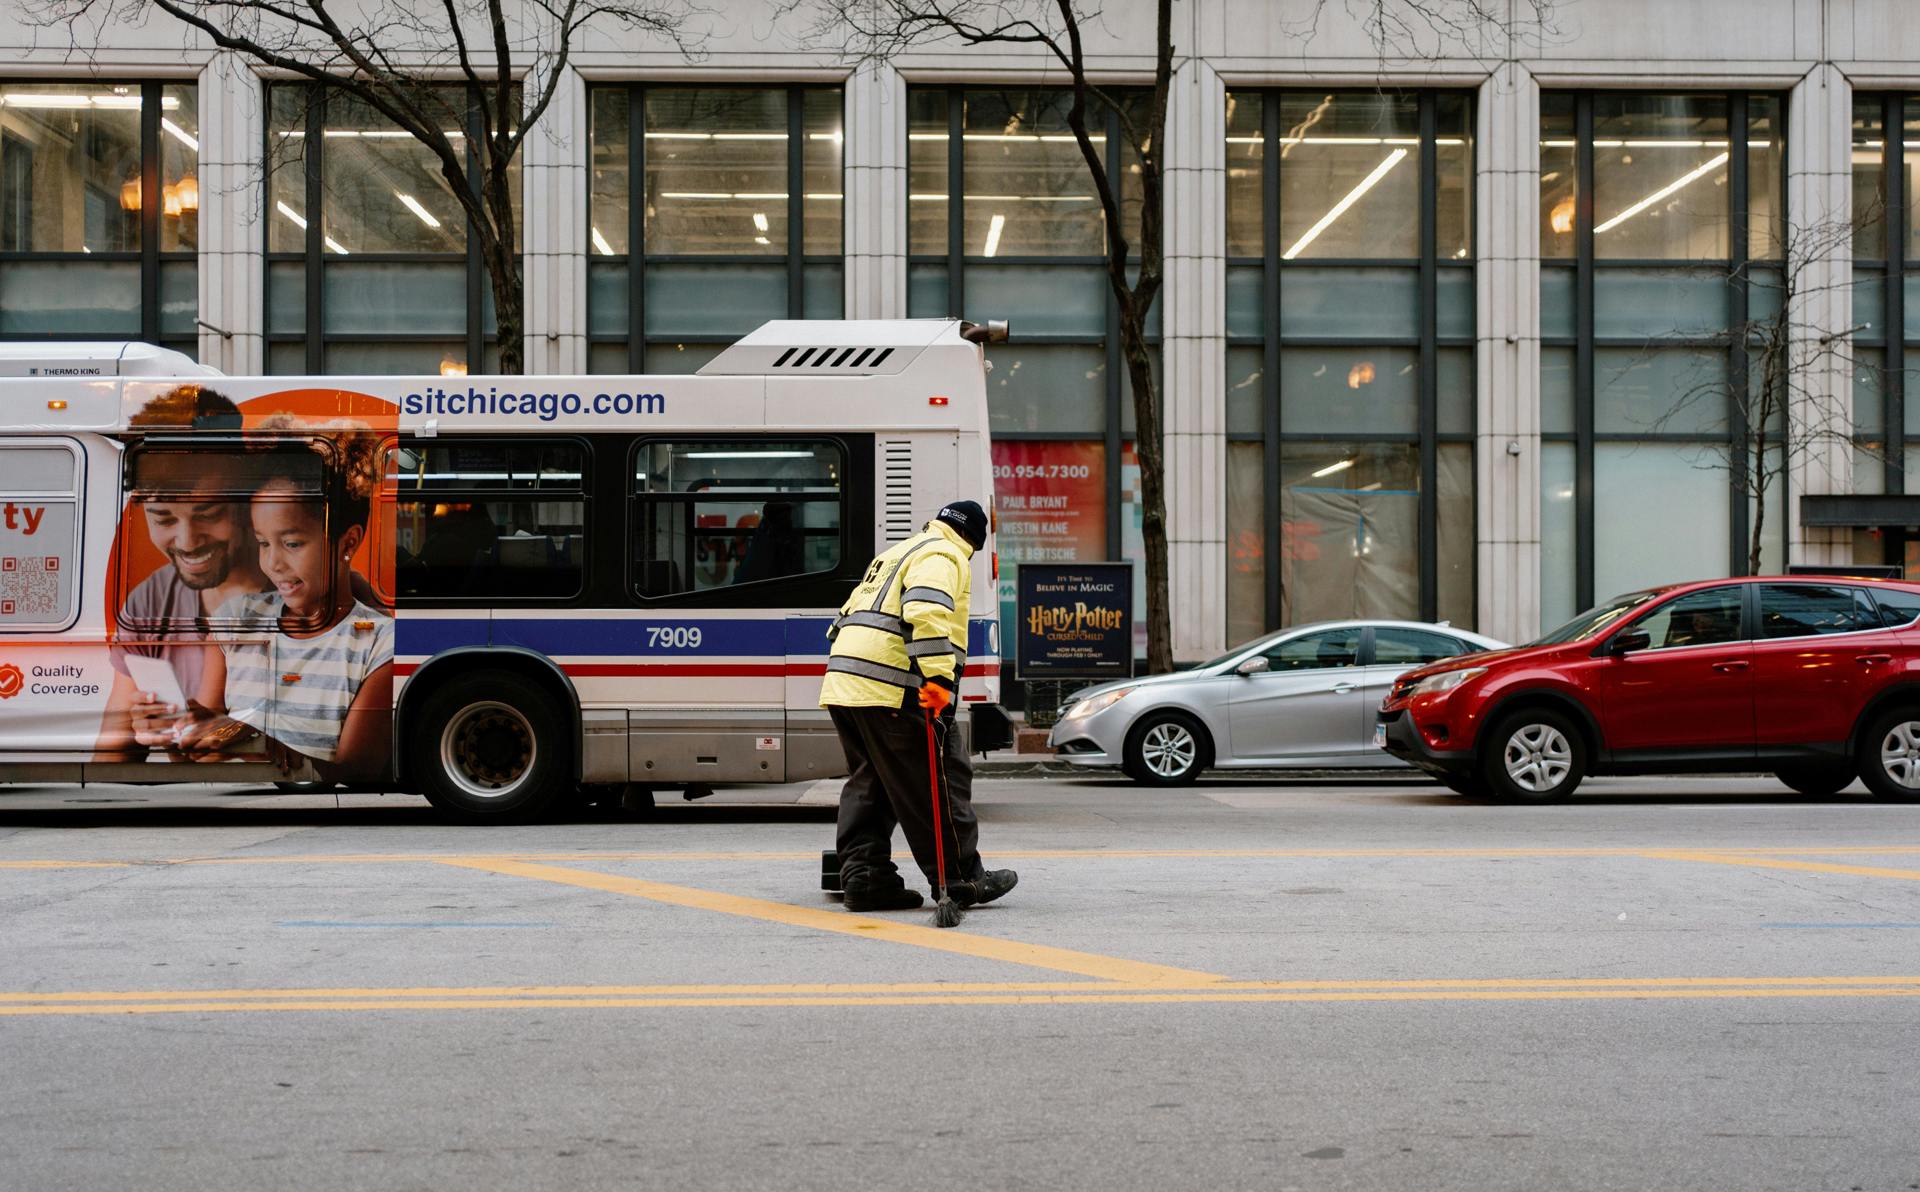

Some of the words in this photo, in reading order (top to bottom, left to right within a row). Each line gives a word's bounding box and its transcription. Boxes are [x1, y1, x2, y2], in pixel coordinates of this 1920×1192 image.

[398, 388, 665, 421] sitchicago.com
[1003, 496, 1026, 508] PAUL
[1030, 496, 1068, 508] BRYANT
[4, 502, 45, 535] ty
[1002, 522, 1038, 534] WESTIN
[1042, 522, 1068, 534] KANE
[1028, 548, 1076, 560] BERTSCHE
[1080, 583, 1114, 592] MAGIC
[1027, 605, 1074, 635] Harry
[1075, 602, 1123, 637] Potter
[646, 627, 702, 648] 7909
[32, 666, 83, 678] Quality
[31, 683, 99, 695] Coverage
